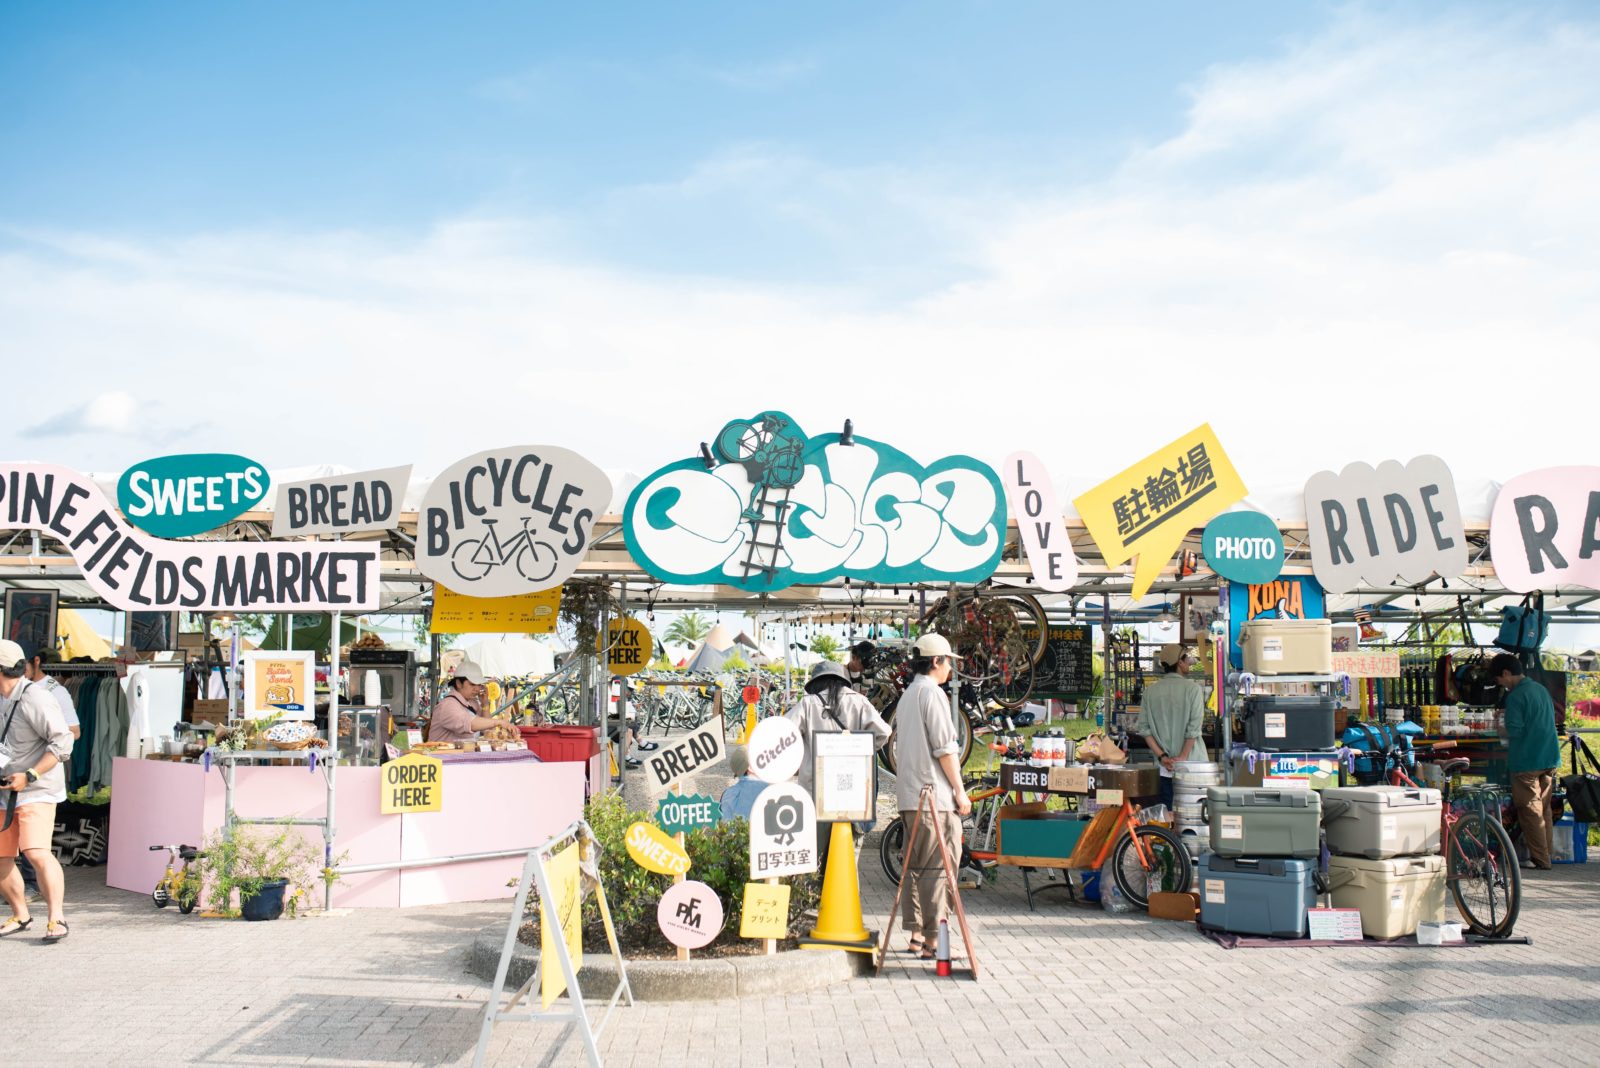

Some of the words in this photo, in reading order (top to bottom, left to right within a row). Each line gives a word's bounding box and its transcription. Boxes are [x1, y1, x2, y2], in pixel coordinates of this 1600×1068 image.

[129, 466, 263, 517] SWEETS
[288, 480, 393, 529] BREAD
[427, 454, 593, 557] BICYCLES
[1113, 442, 1215, 535] 駐輪場
[1017, 459, 1063, 580] LOVE
[1321, 483, 1455, 565] RIDE
[71, 509, 206, 607] FIELDS
[212, 552, 375, 607] MARKET
[1215, 536, 1276, 560] PHOTO
[1248, 580, 1305, 620] KONA
[608, 648, 641, 664] HERE
[609, 630, 639, 646] PICK
[650, 732, 719, 785] BREAD
[756, 731, 797, 770] Circles
[388, 763, 437, 784] ORDER
[1013, 771, 1038, 786] BEER
[393, 786, 431, 807] HERE
[661, 802, 712, 826] COFFEE
[628, 825, 688, 873] SWEETS
